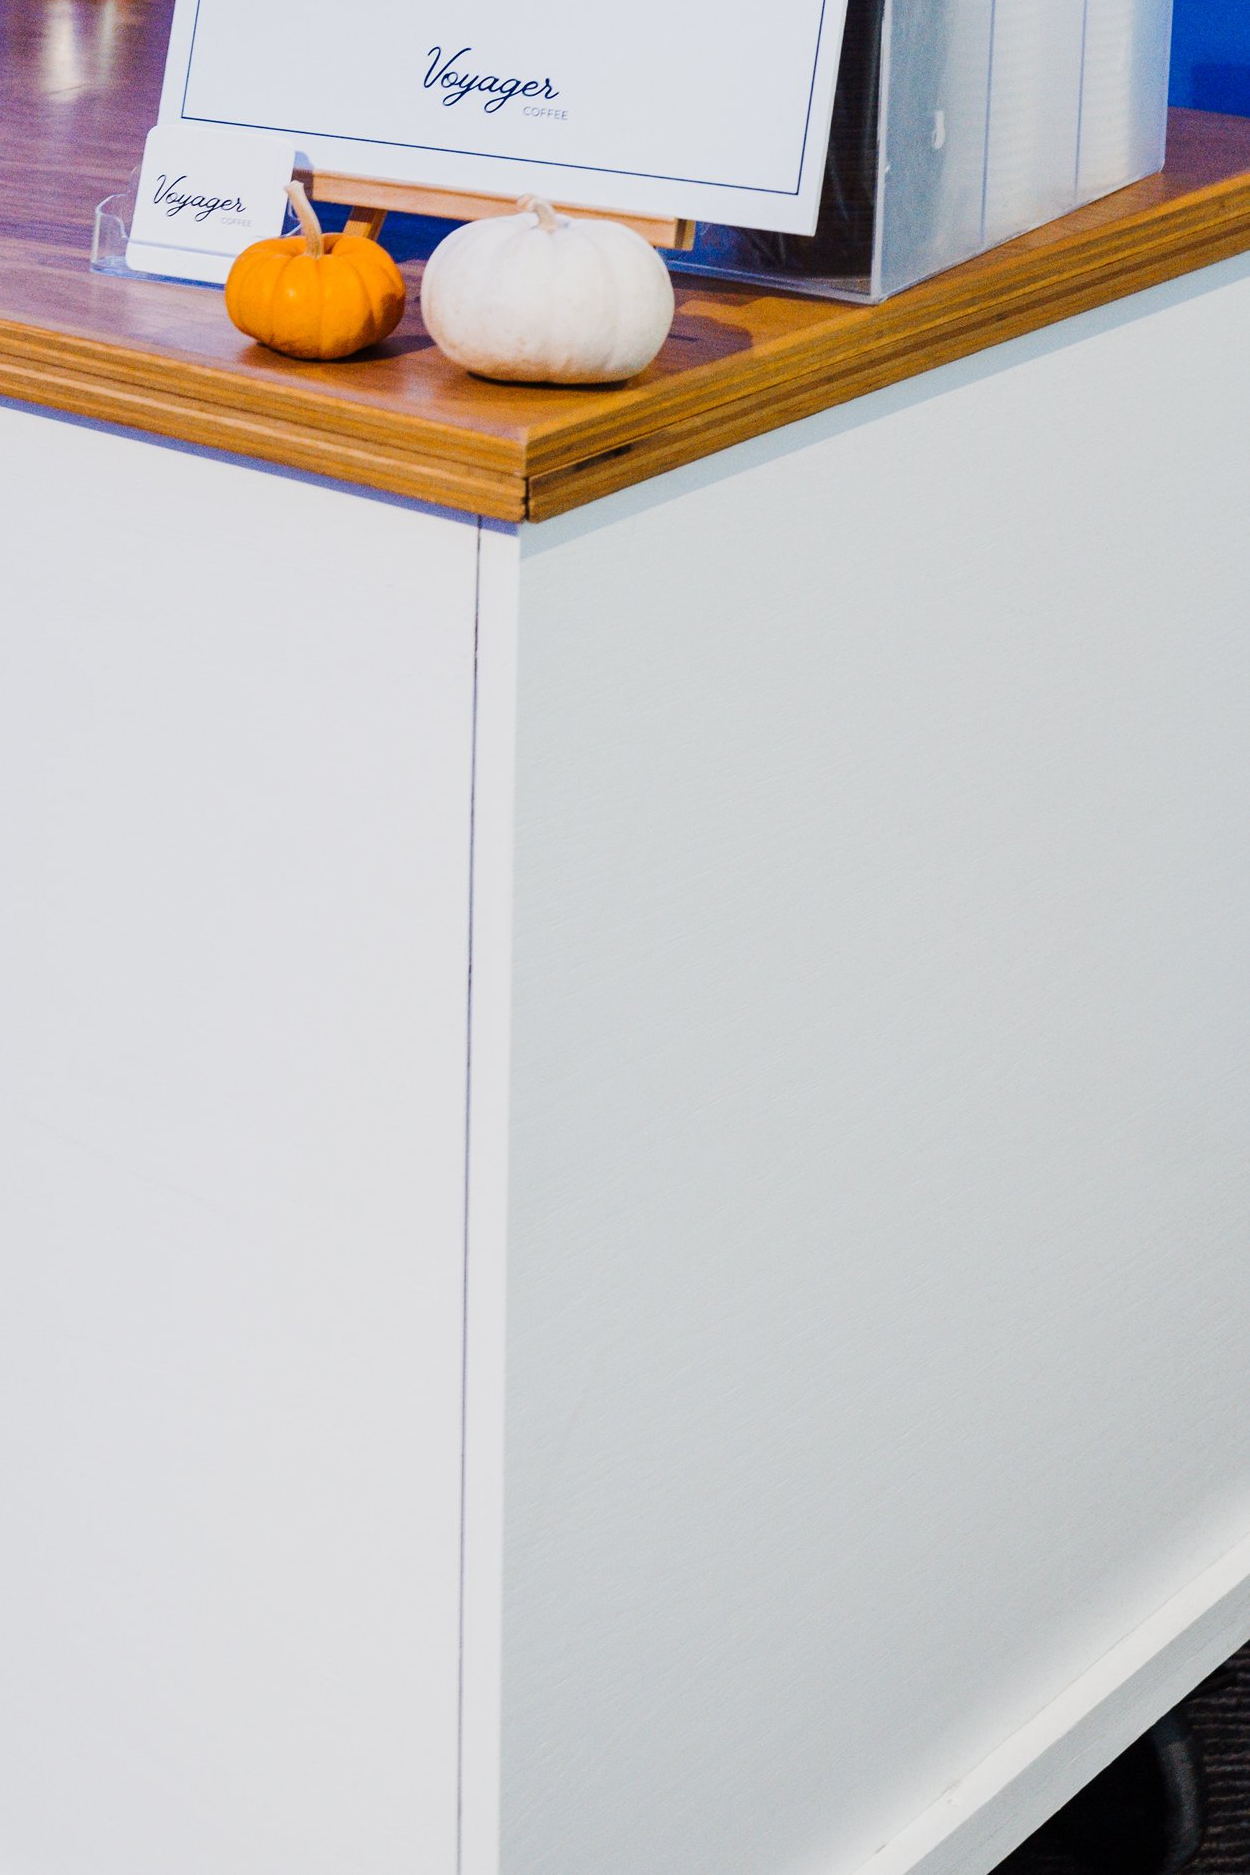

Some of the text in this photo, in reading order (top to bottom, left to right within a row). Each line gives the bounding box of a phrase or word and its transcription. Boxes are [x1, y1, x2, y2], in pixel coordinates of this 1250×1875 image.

[423, 46, 560, 114] Voyager
[522, 105, 570, 121] COFFEE
[153, 174, 247, 223] Voyager
[221, 217, 252, 228] COFFEE
